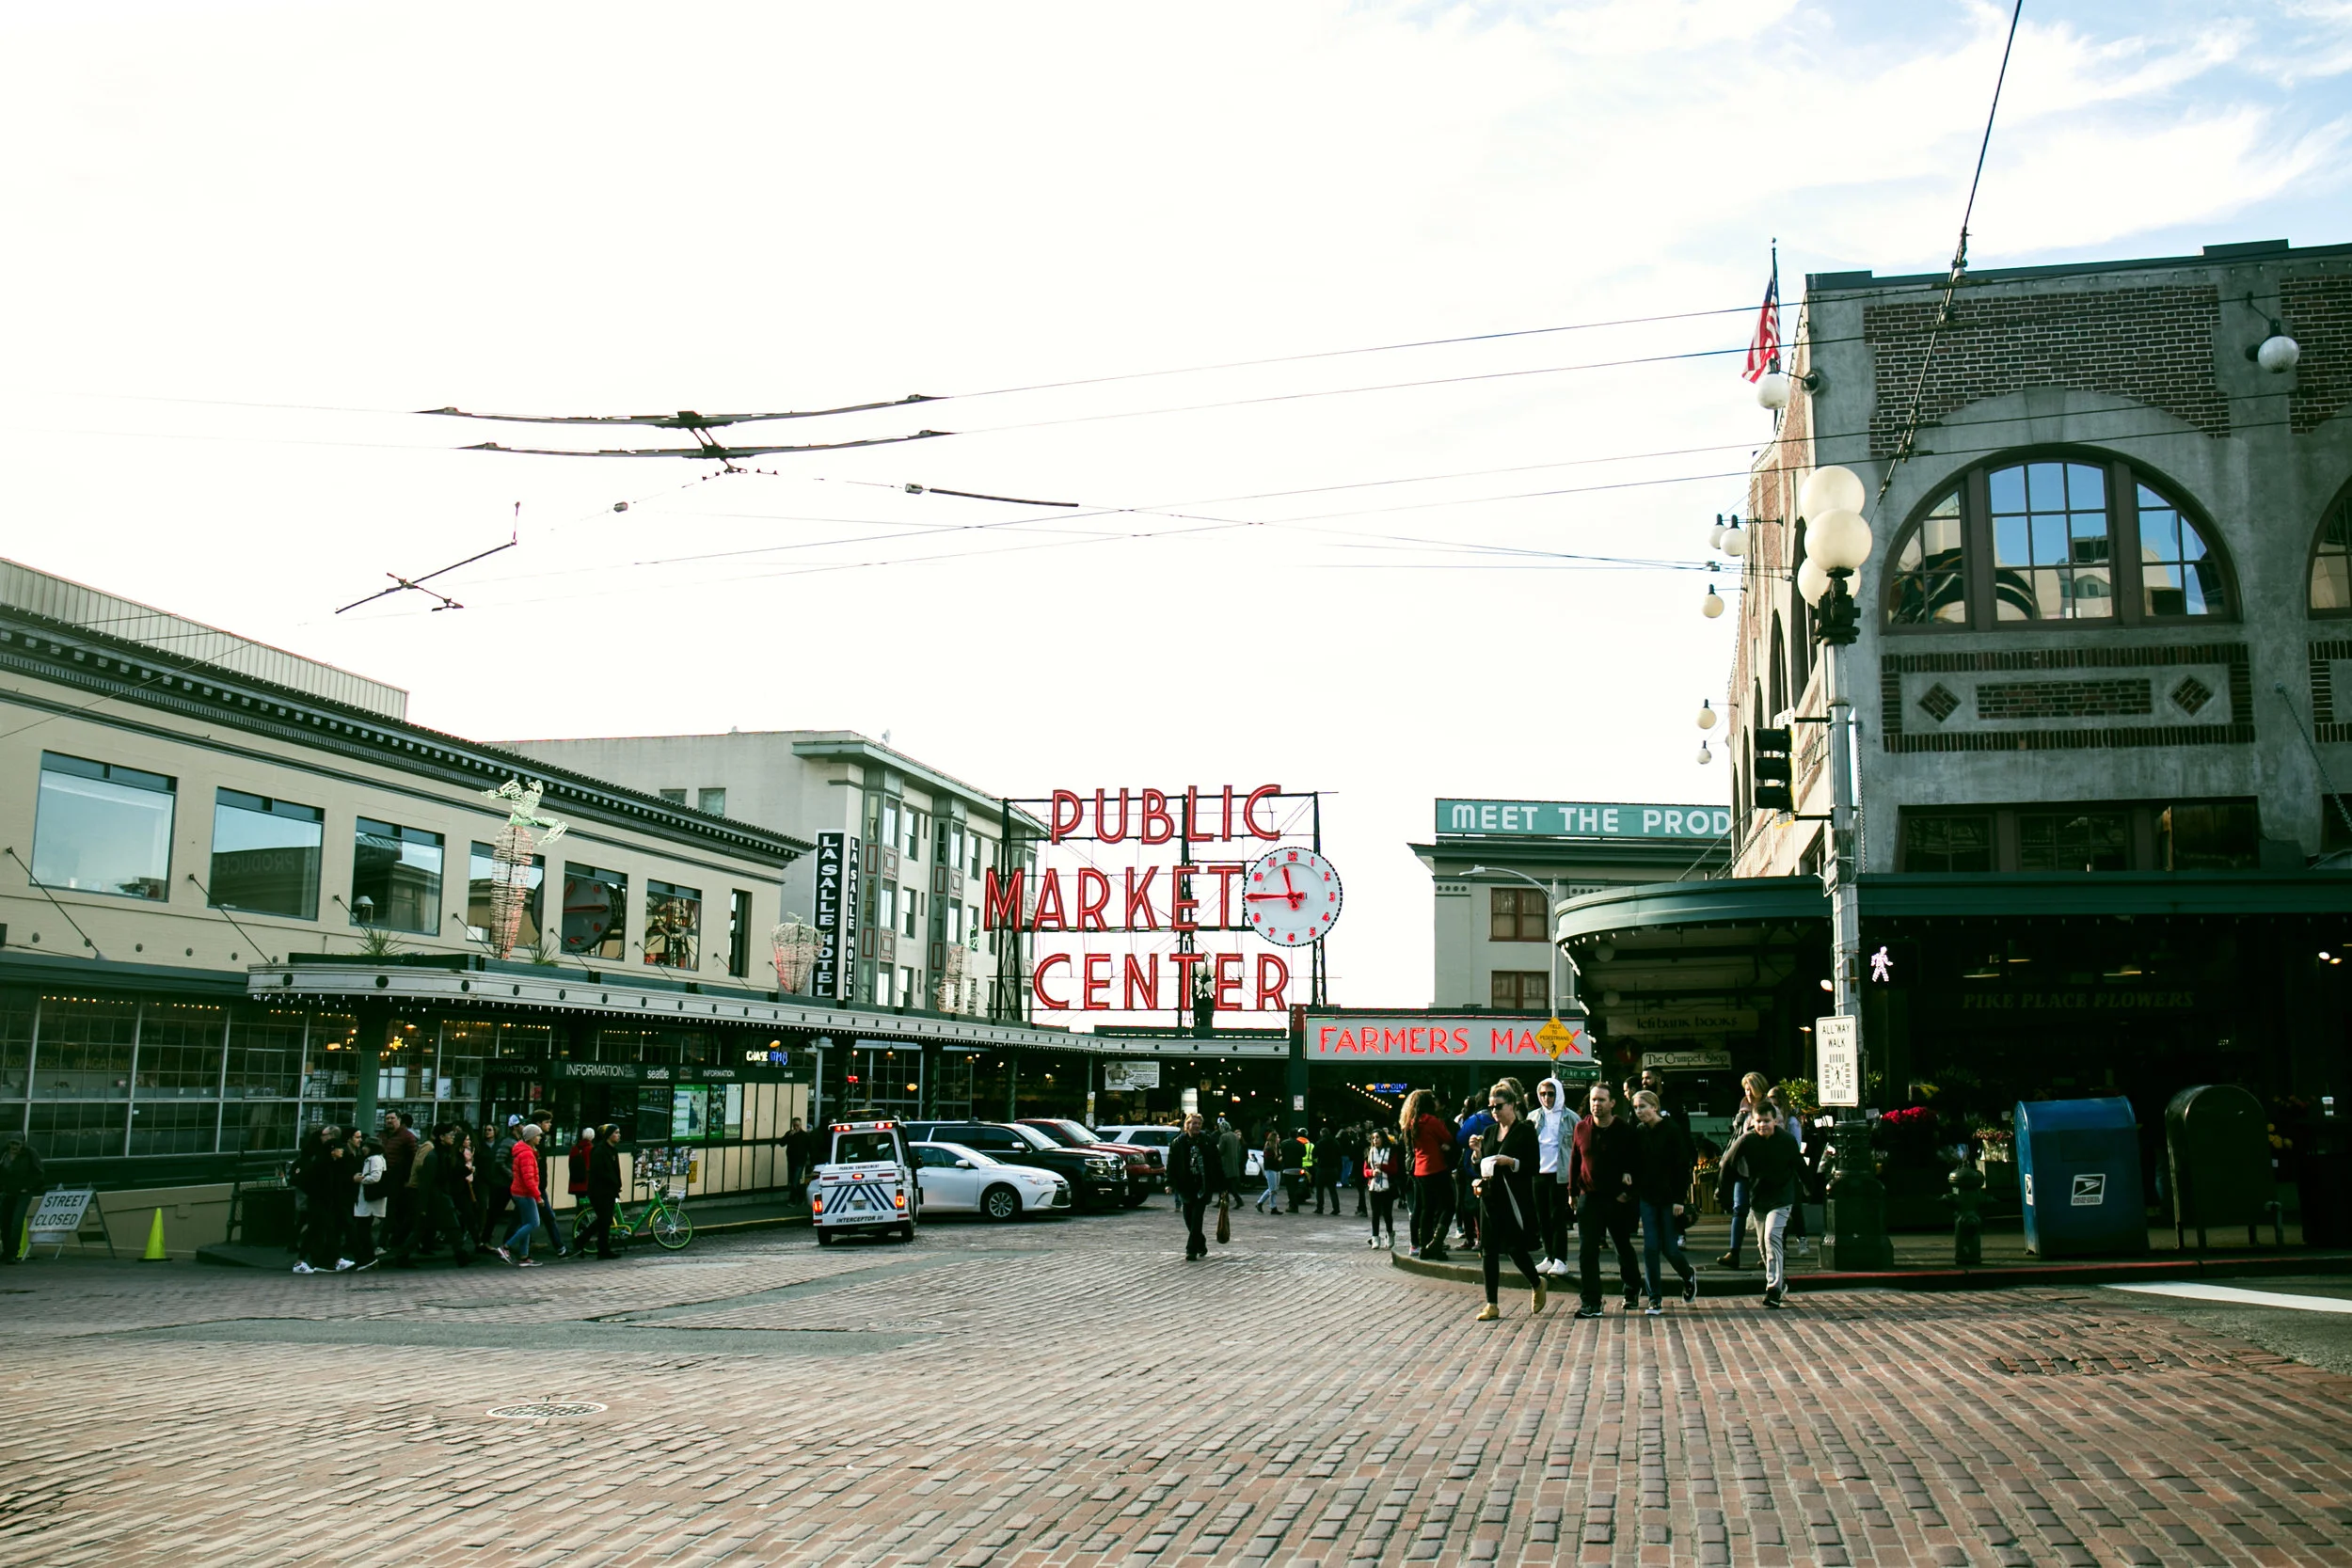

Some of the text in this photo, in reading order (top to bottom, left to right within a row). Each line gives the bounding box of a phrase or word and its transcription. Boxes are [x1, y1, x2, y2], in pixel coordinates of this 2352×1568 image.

[1051, 784, 1281, 845] PUBLIC
[1452, 803, 1538, 830] MEET
[1558, 806, 1619, 832] THE
[984, 865, 1244, 933] MARKET
[817, 835, 838, 997] LA SALLE HOTEL
[1033, 952, 1288, 1011] CENTER
[1962, 990, 2196, 1009] PIKE PLACE FLOWERS
[1821, 1025, 1835, 1035] ALL
[1319, 1026, 1470, 1055] FARMERS
[1828, 1038, 1846, 1048] WALK
[1645, 1052, 1727, 1066] The Crumpet Shop
[565, 1064, 625, 1077] INFORMATION
[1562, 1069, 1578, 1077] Pike
[44, 1195, 87, 1208] STREET
[35, 1213, 78, 1227] CLOSED
[836, 1215, 875, 1224] INTERCEPTOR
